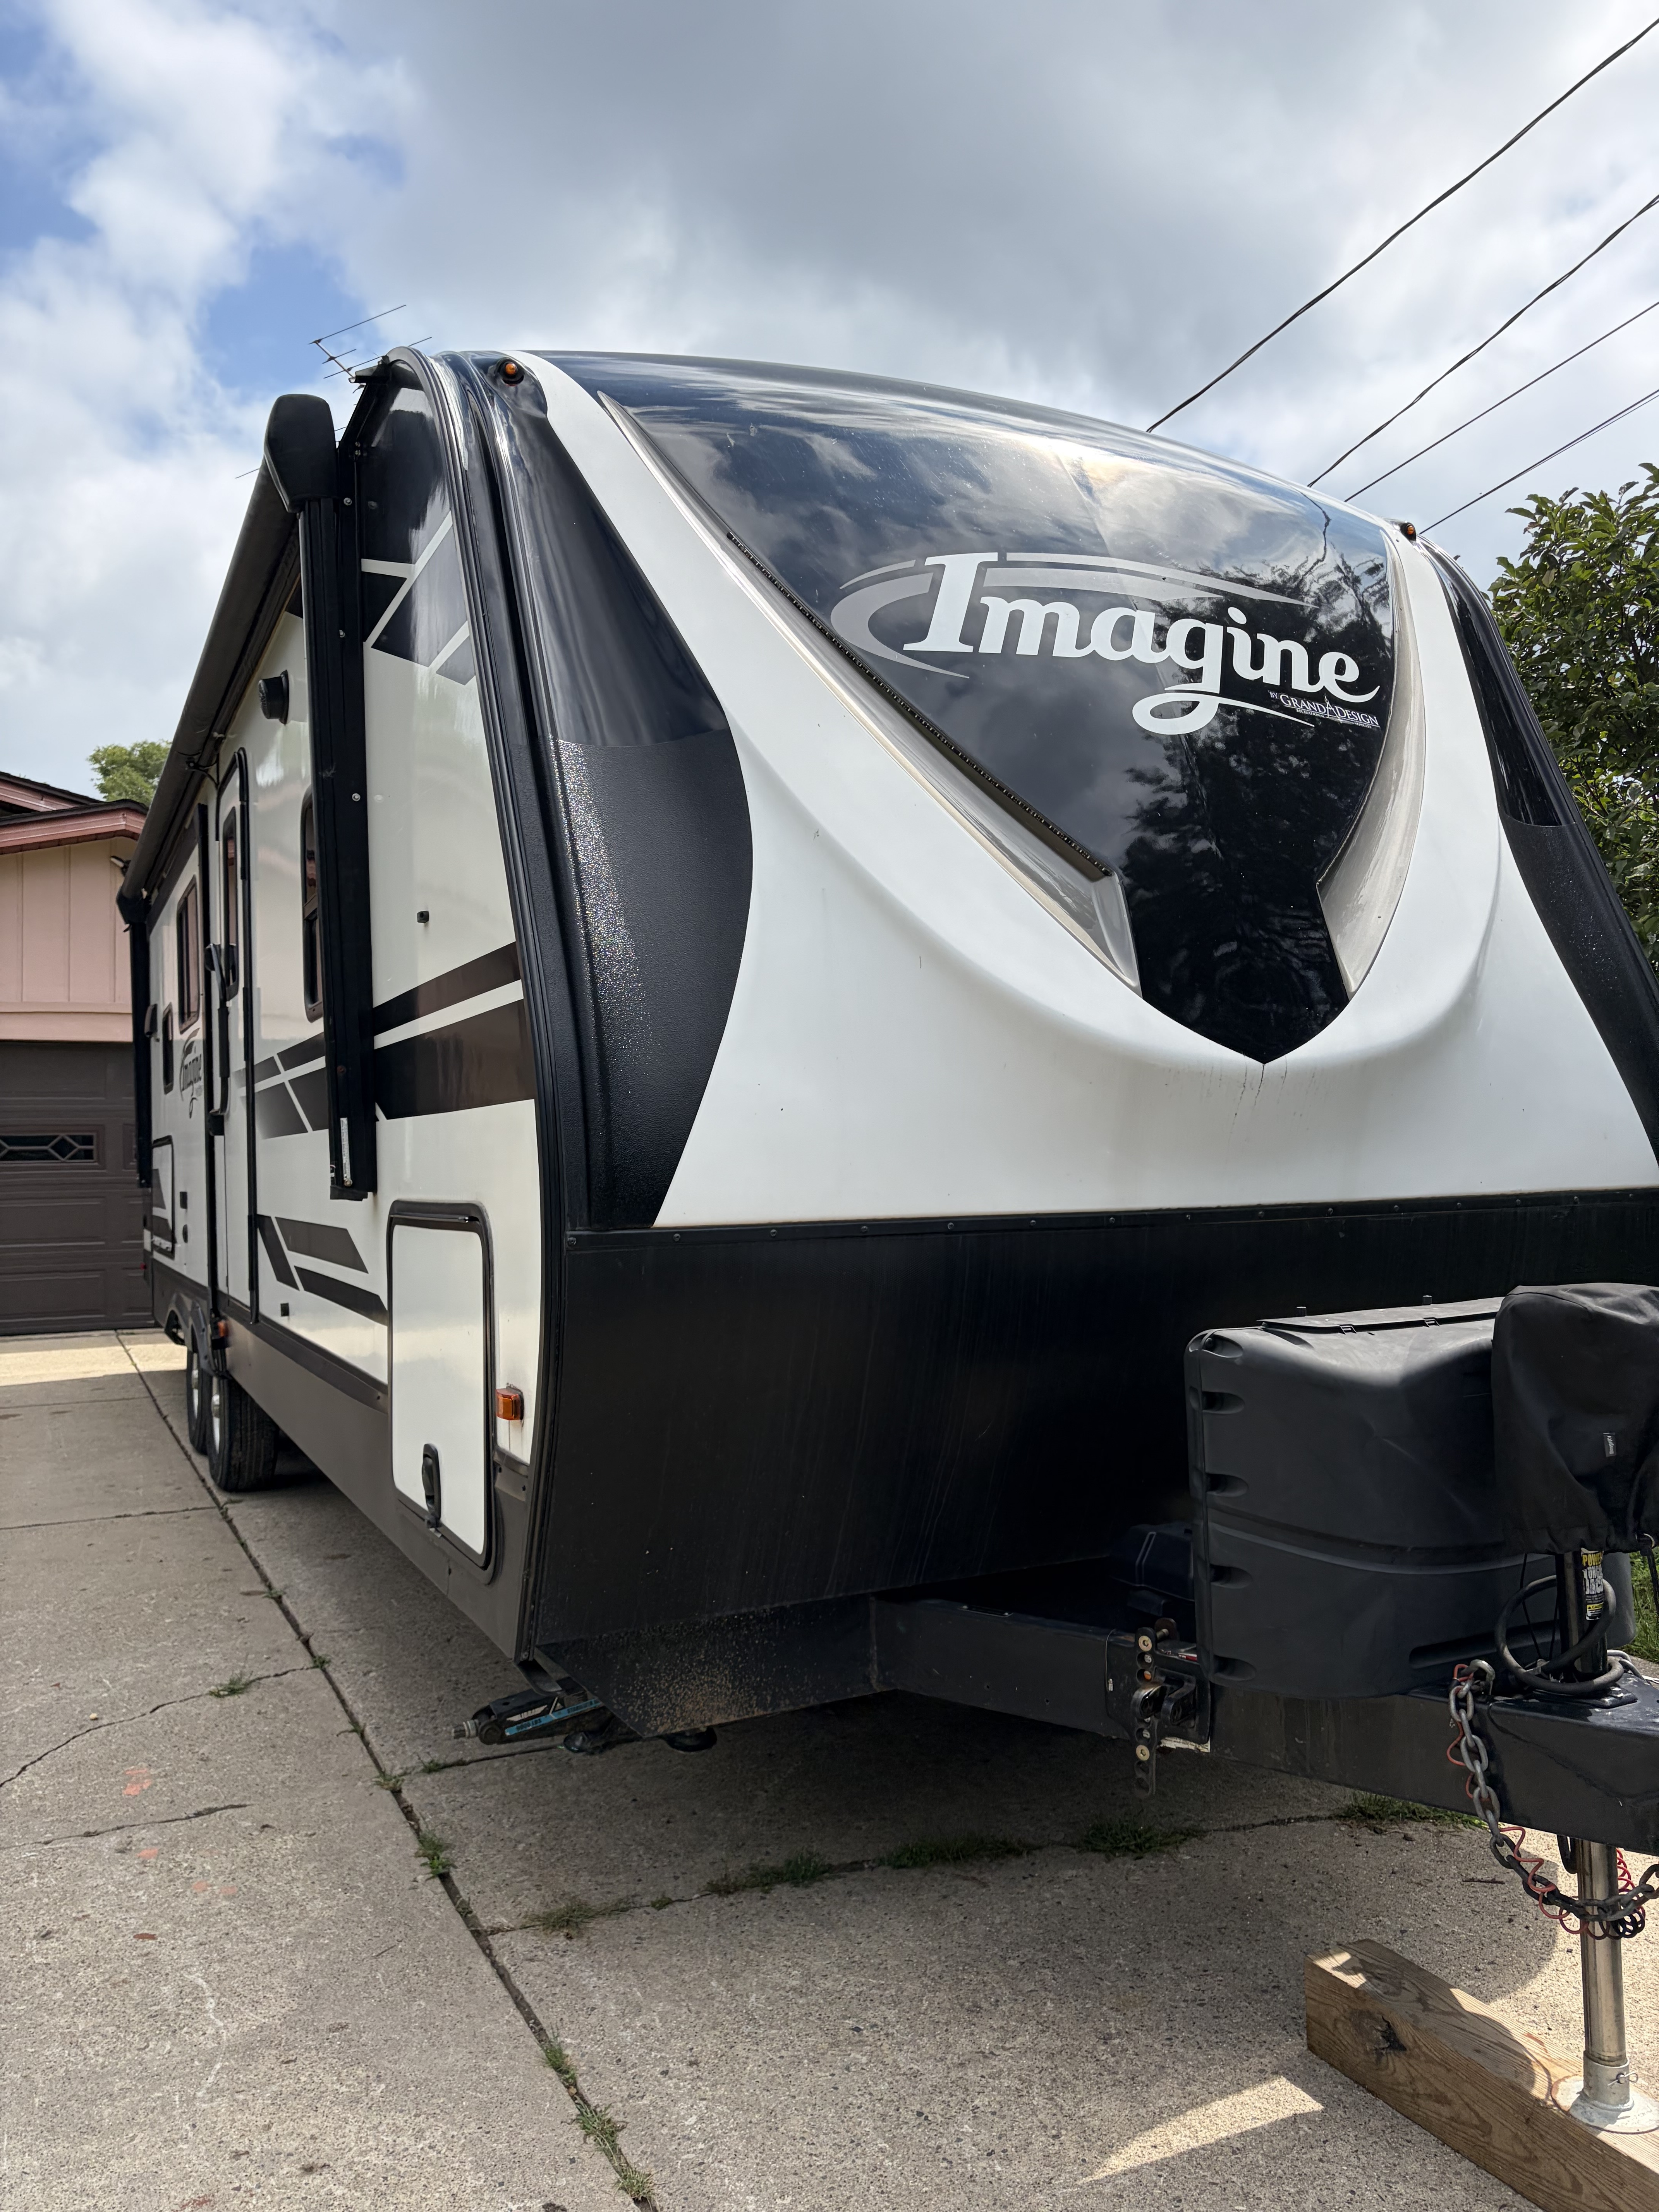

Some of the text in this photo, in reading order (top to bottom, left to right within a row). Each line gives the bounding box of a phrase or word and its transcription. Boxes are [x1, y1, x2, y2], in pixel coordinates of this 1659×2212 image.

[903, 552, 1380, 735] Imagine
[1280, 694, 1326, 713] GRAND
[1334, 706, 1379, 726] DESIGN
[1582, 1565, 1603, 1579] TONG
